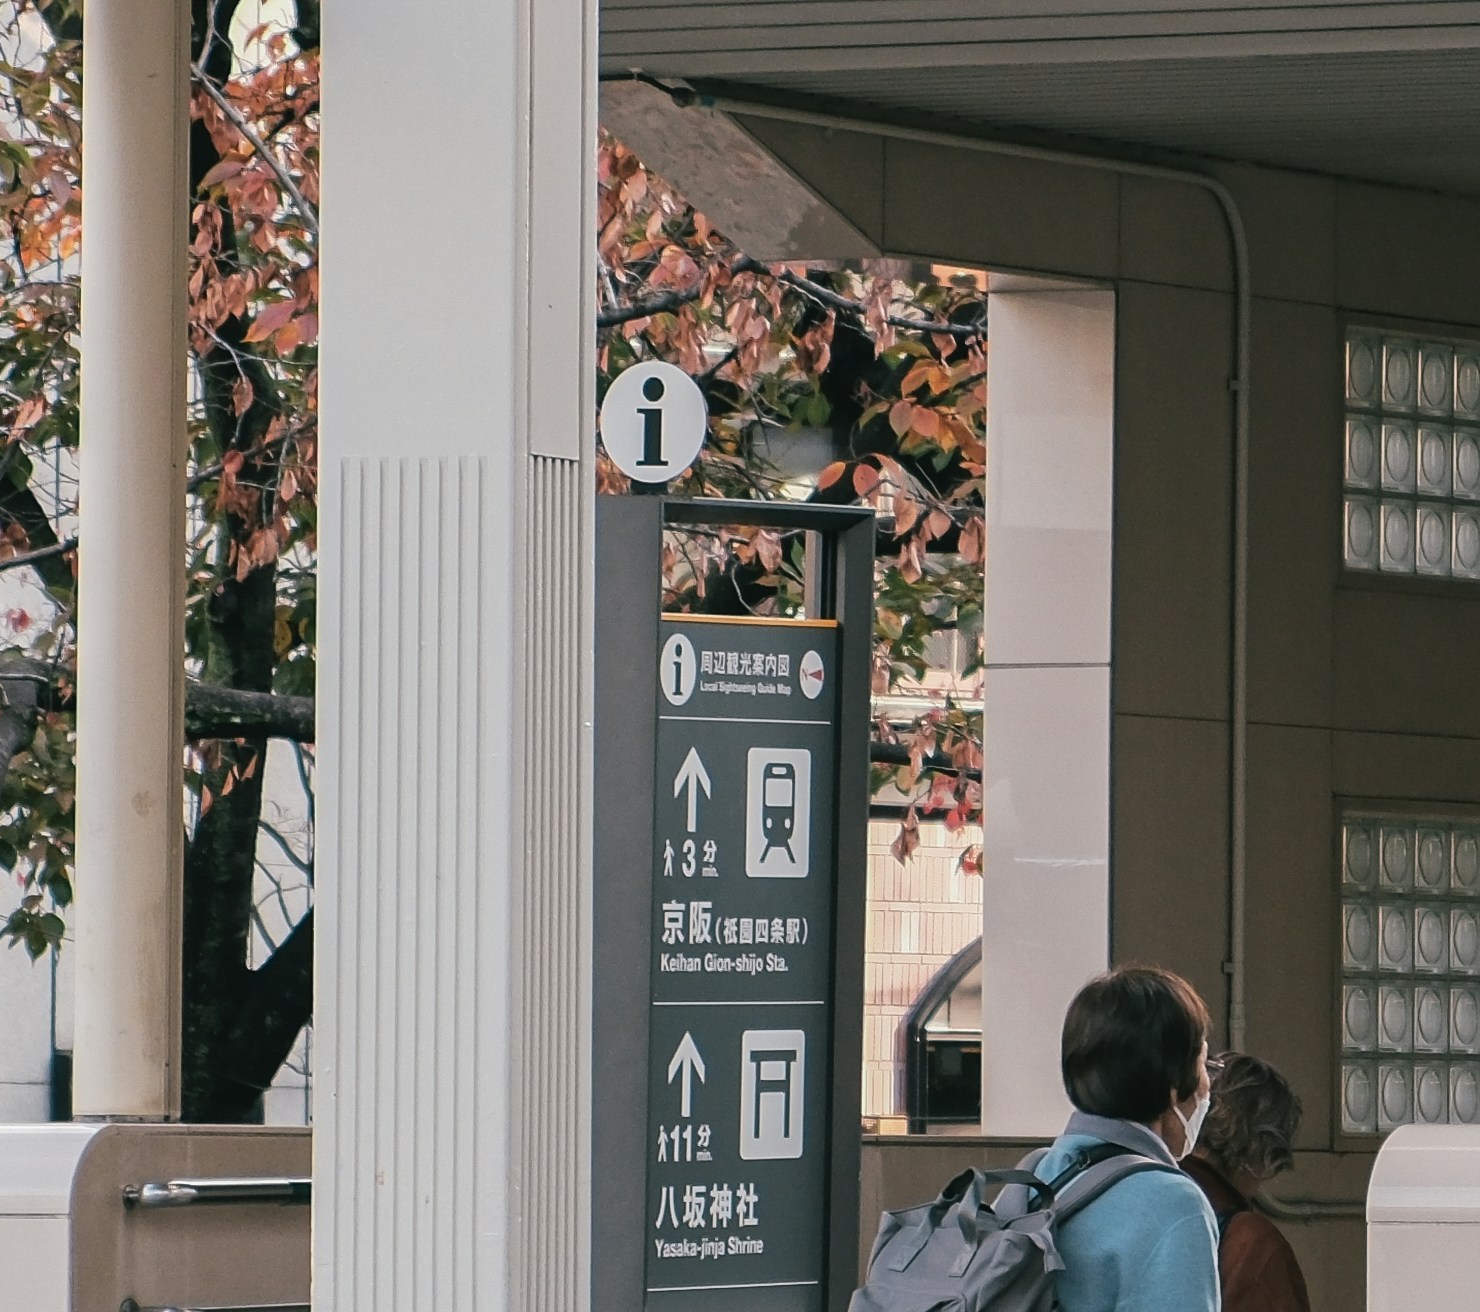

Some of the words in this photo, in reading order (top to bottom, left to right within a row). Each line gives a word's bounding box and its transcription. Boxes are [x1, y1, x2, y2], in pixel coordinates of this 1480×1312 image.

[700, 651, 790, 678] 周辺観光案内図
[660, 953, 702, 972] Keihan
[704, 953, 764, 976] Gion-shijo
[766, 953, 789, 972] Sta.
[655, 1183, 759, 1229] 八坂神社
[655, 1235, 725, 1261] Yasaka-jinja
[727, 1235, 764, 1255] Shrine
